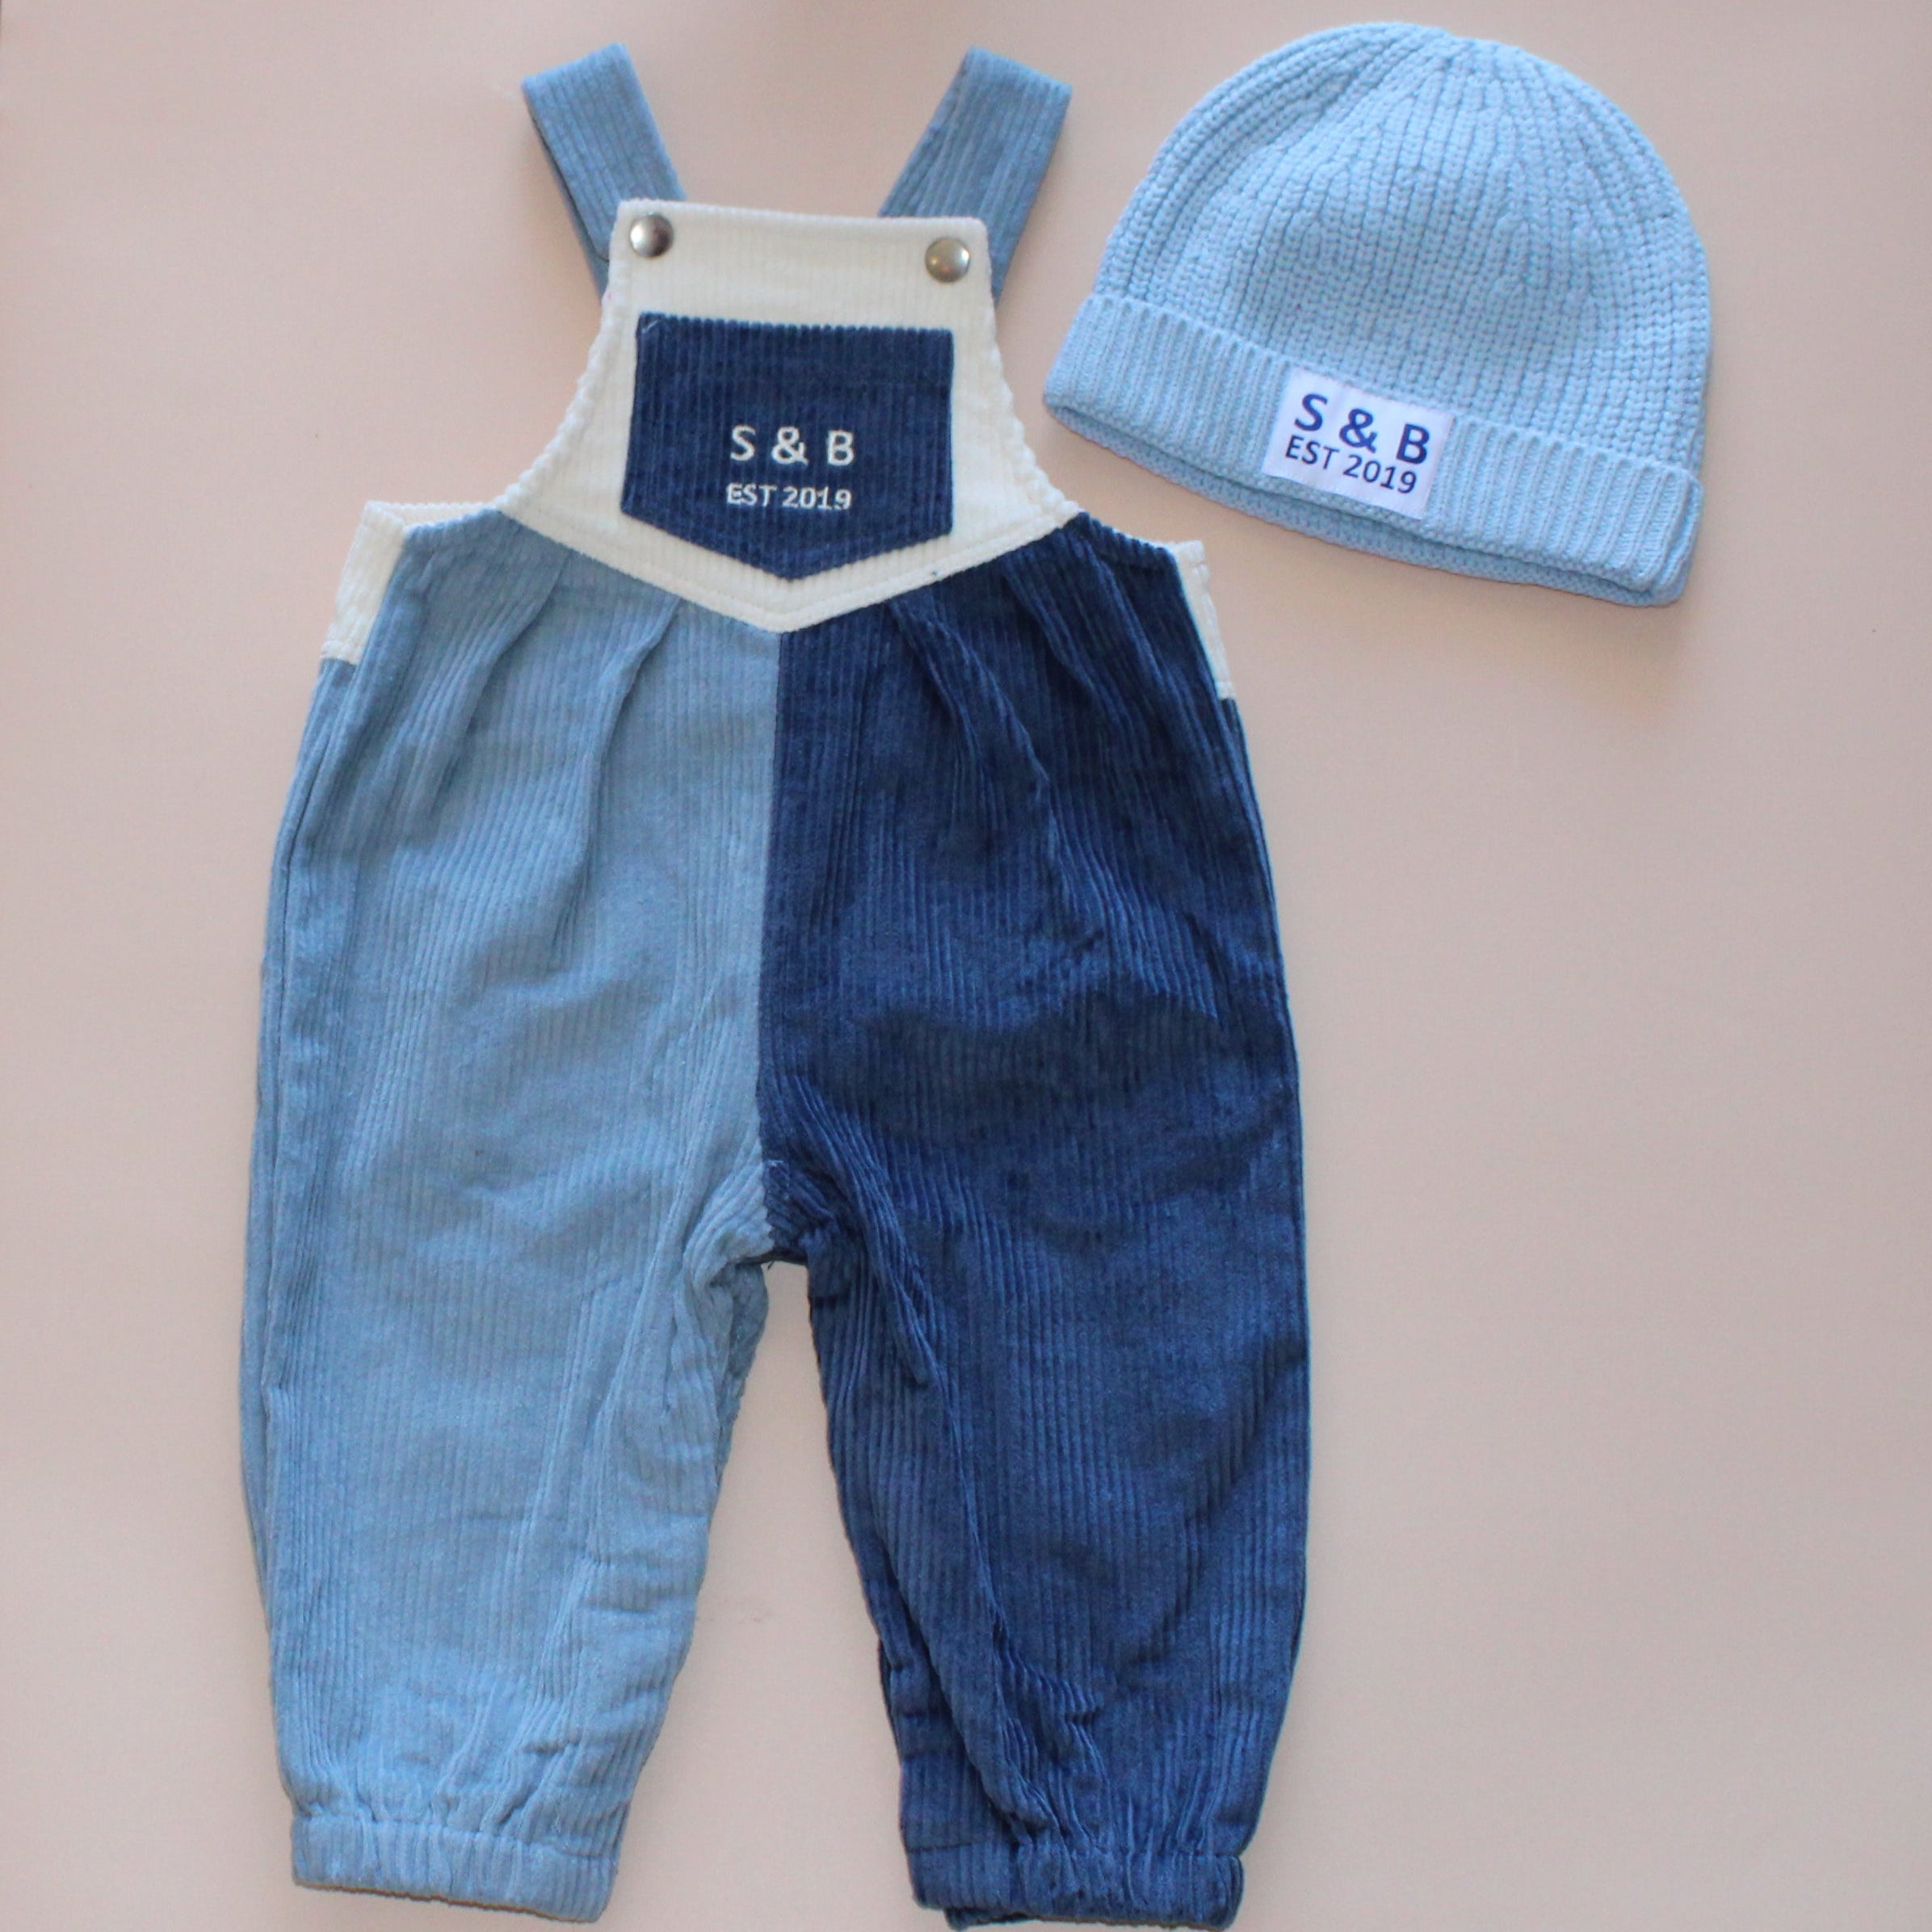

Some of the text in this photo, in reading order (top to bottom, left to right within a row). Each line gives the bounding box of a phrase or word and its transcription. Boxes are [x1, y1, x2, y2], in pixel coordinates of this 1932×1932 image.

[730, 425, 855, 466] S & B
[1294, 393, 1431, 465] S & B
[1285, 435, 1418, 494] EST 2019
[726, 482, 852, 510] EST 2019
